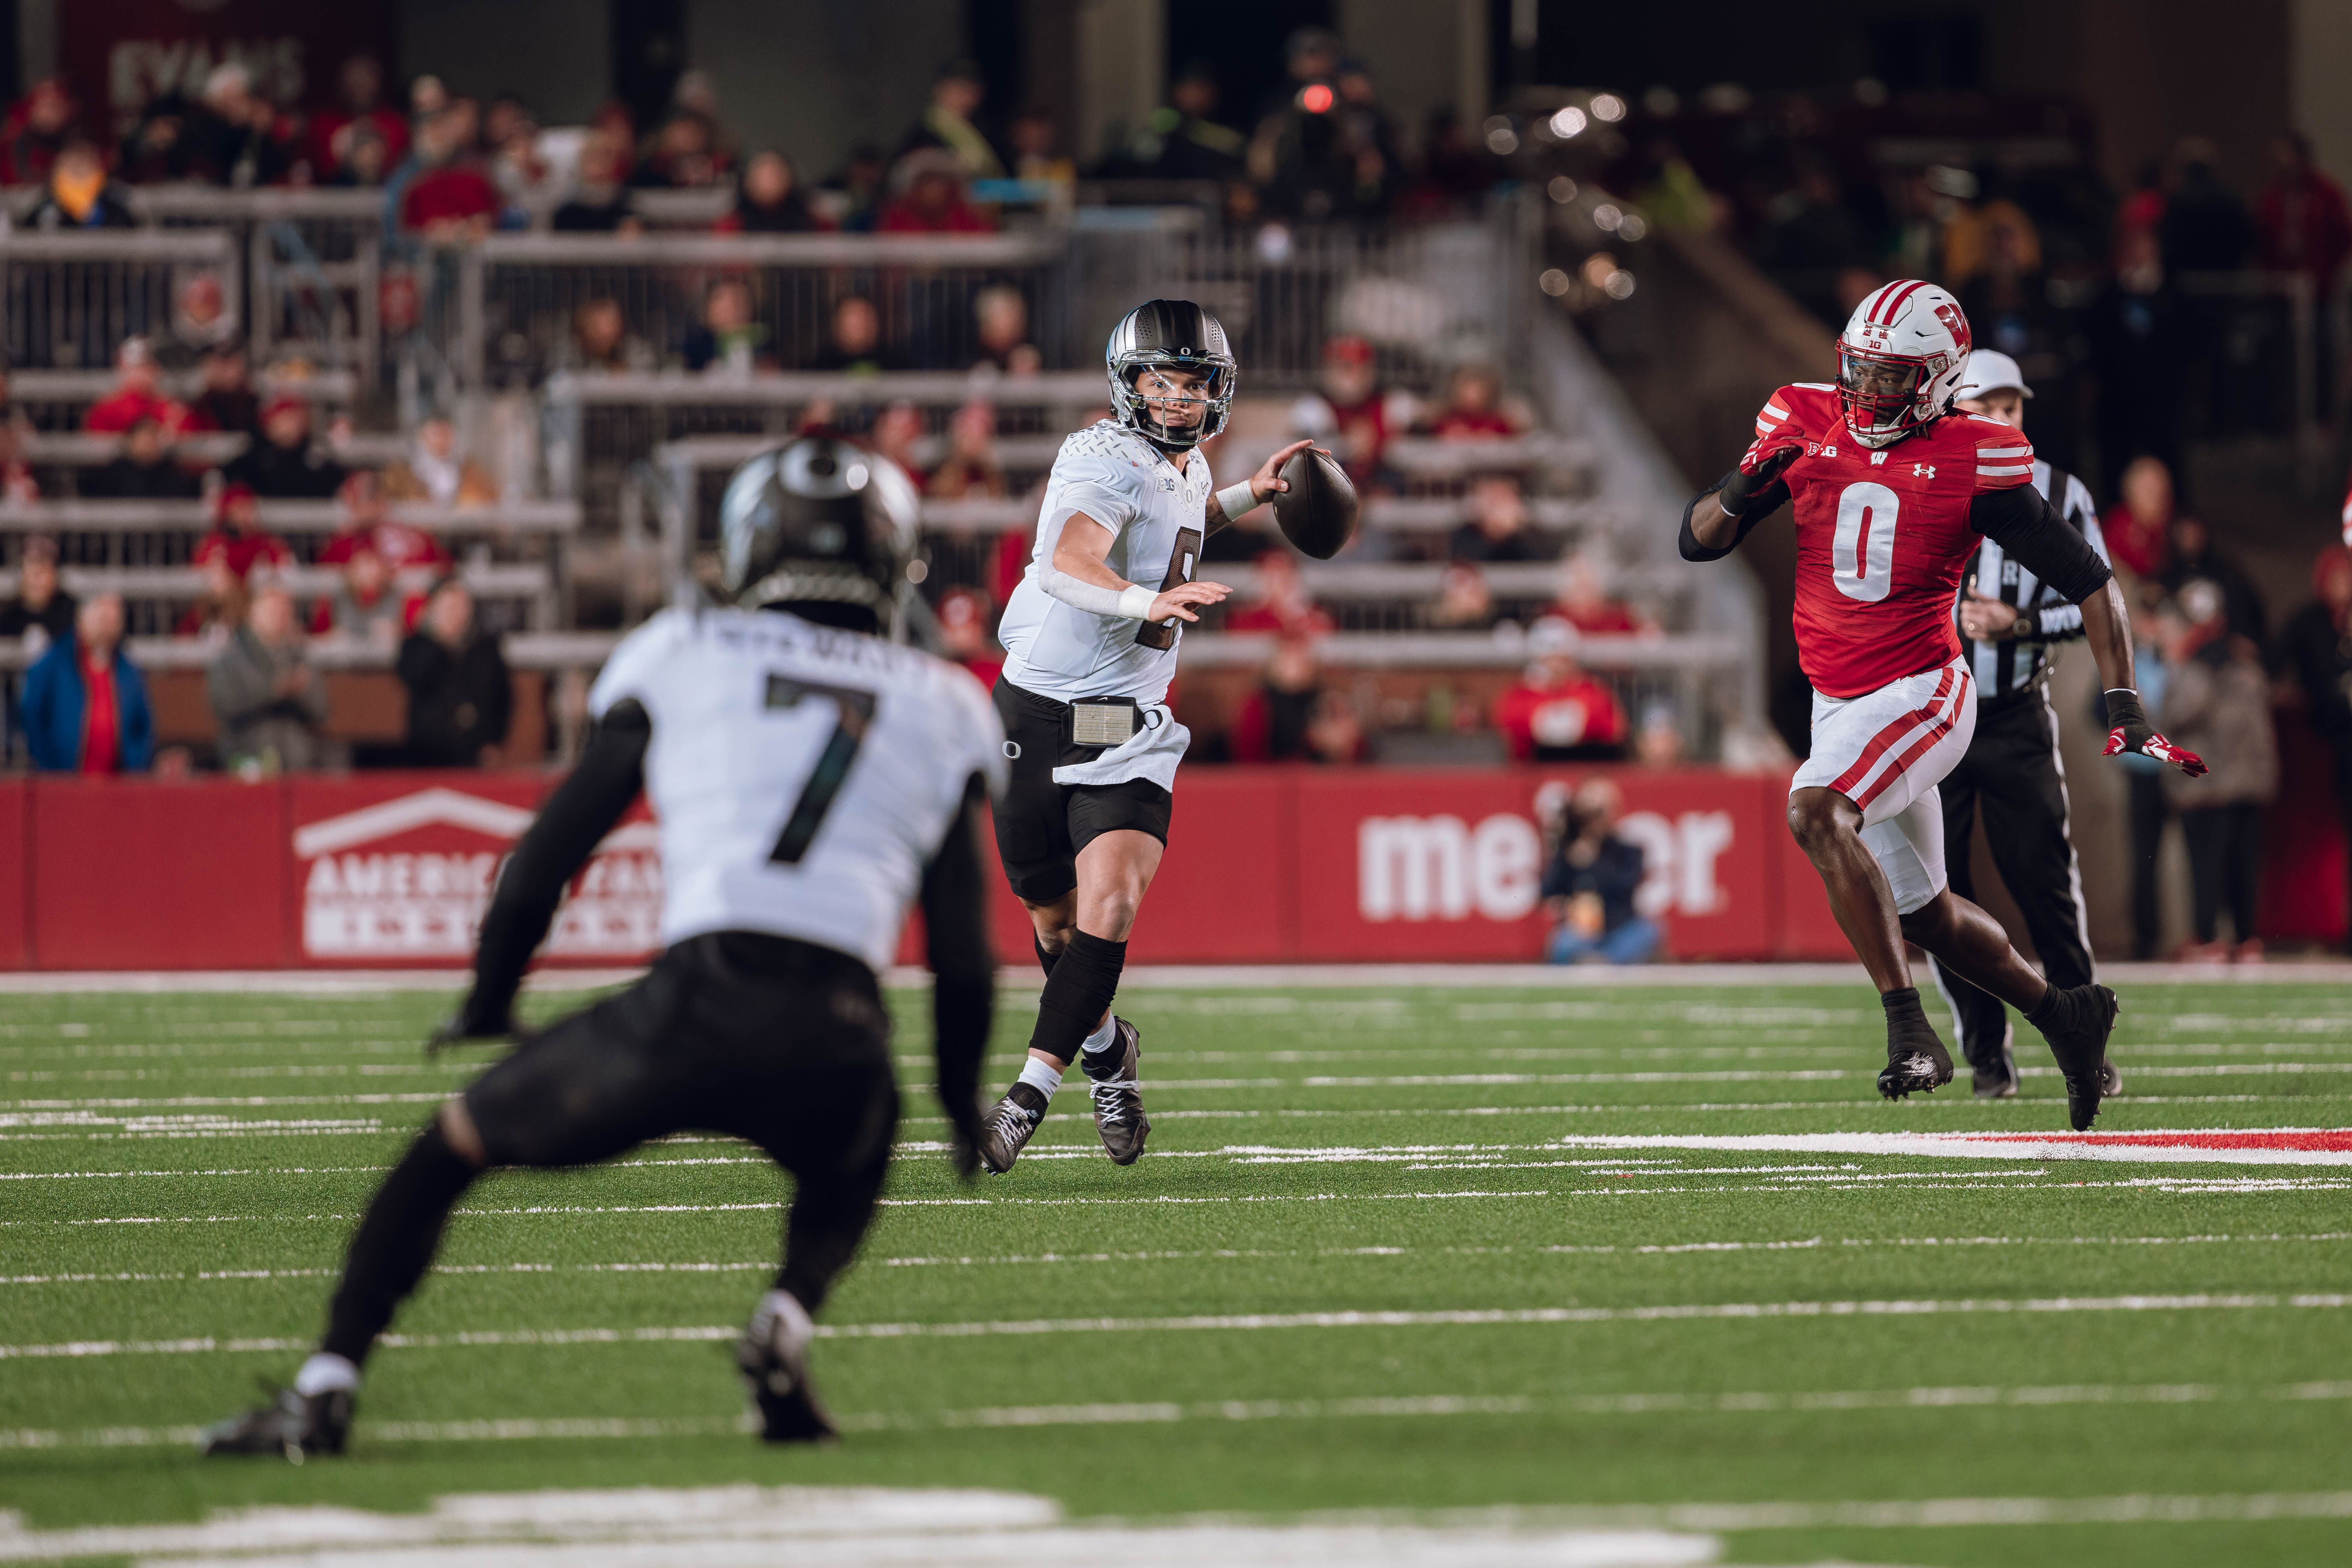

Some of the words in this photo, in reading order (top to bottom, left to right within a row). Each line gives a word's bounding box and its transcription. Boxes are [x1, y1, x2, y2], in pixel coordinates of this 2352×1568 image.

[1871, 452, 1888, 465] W
[1832, 481, 1900, 602] 0
[2002, 560, 2018, 585] R
[764, 672, 878, 865] 7
